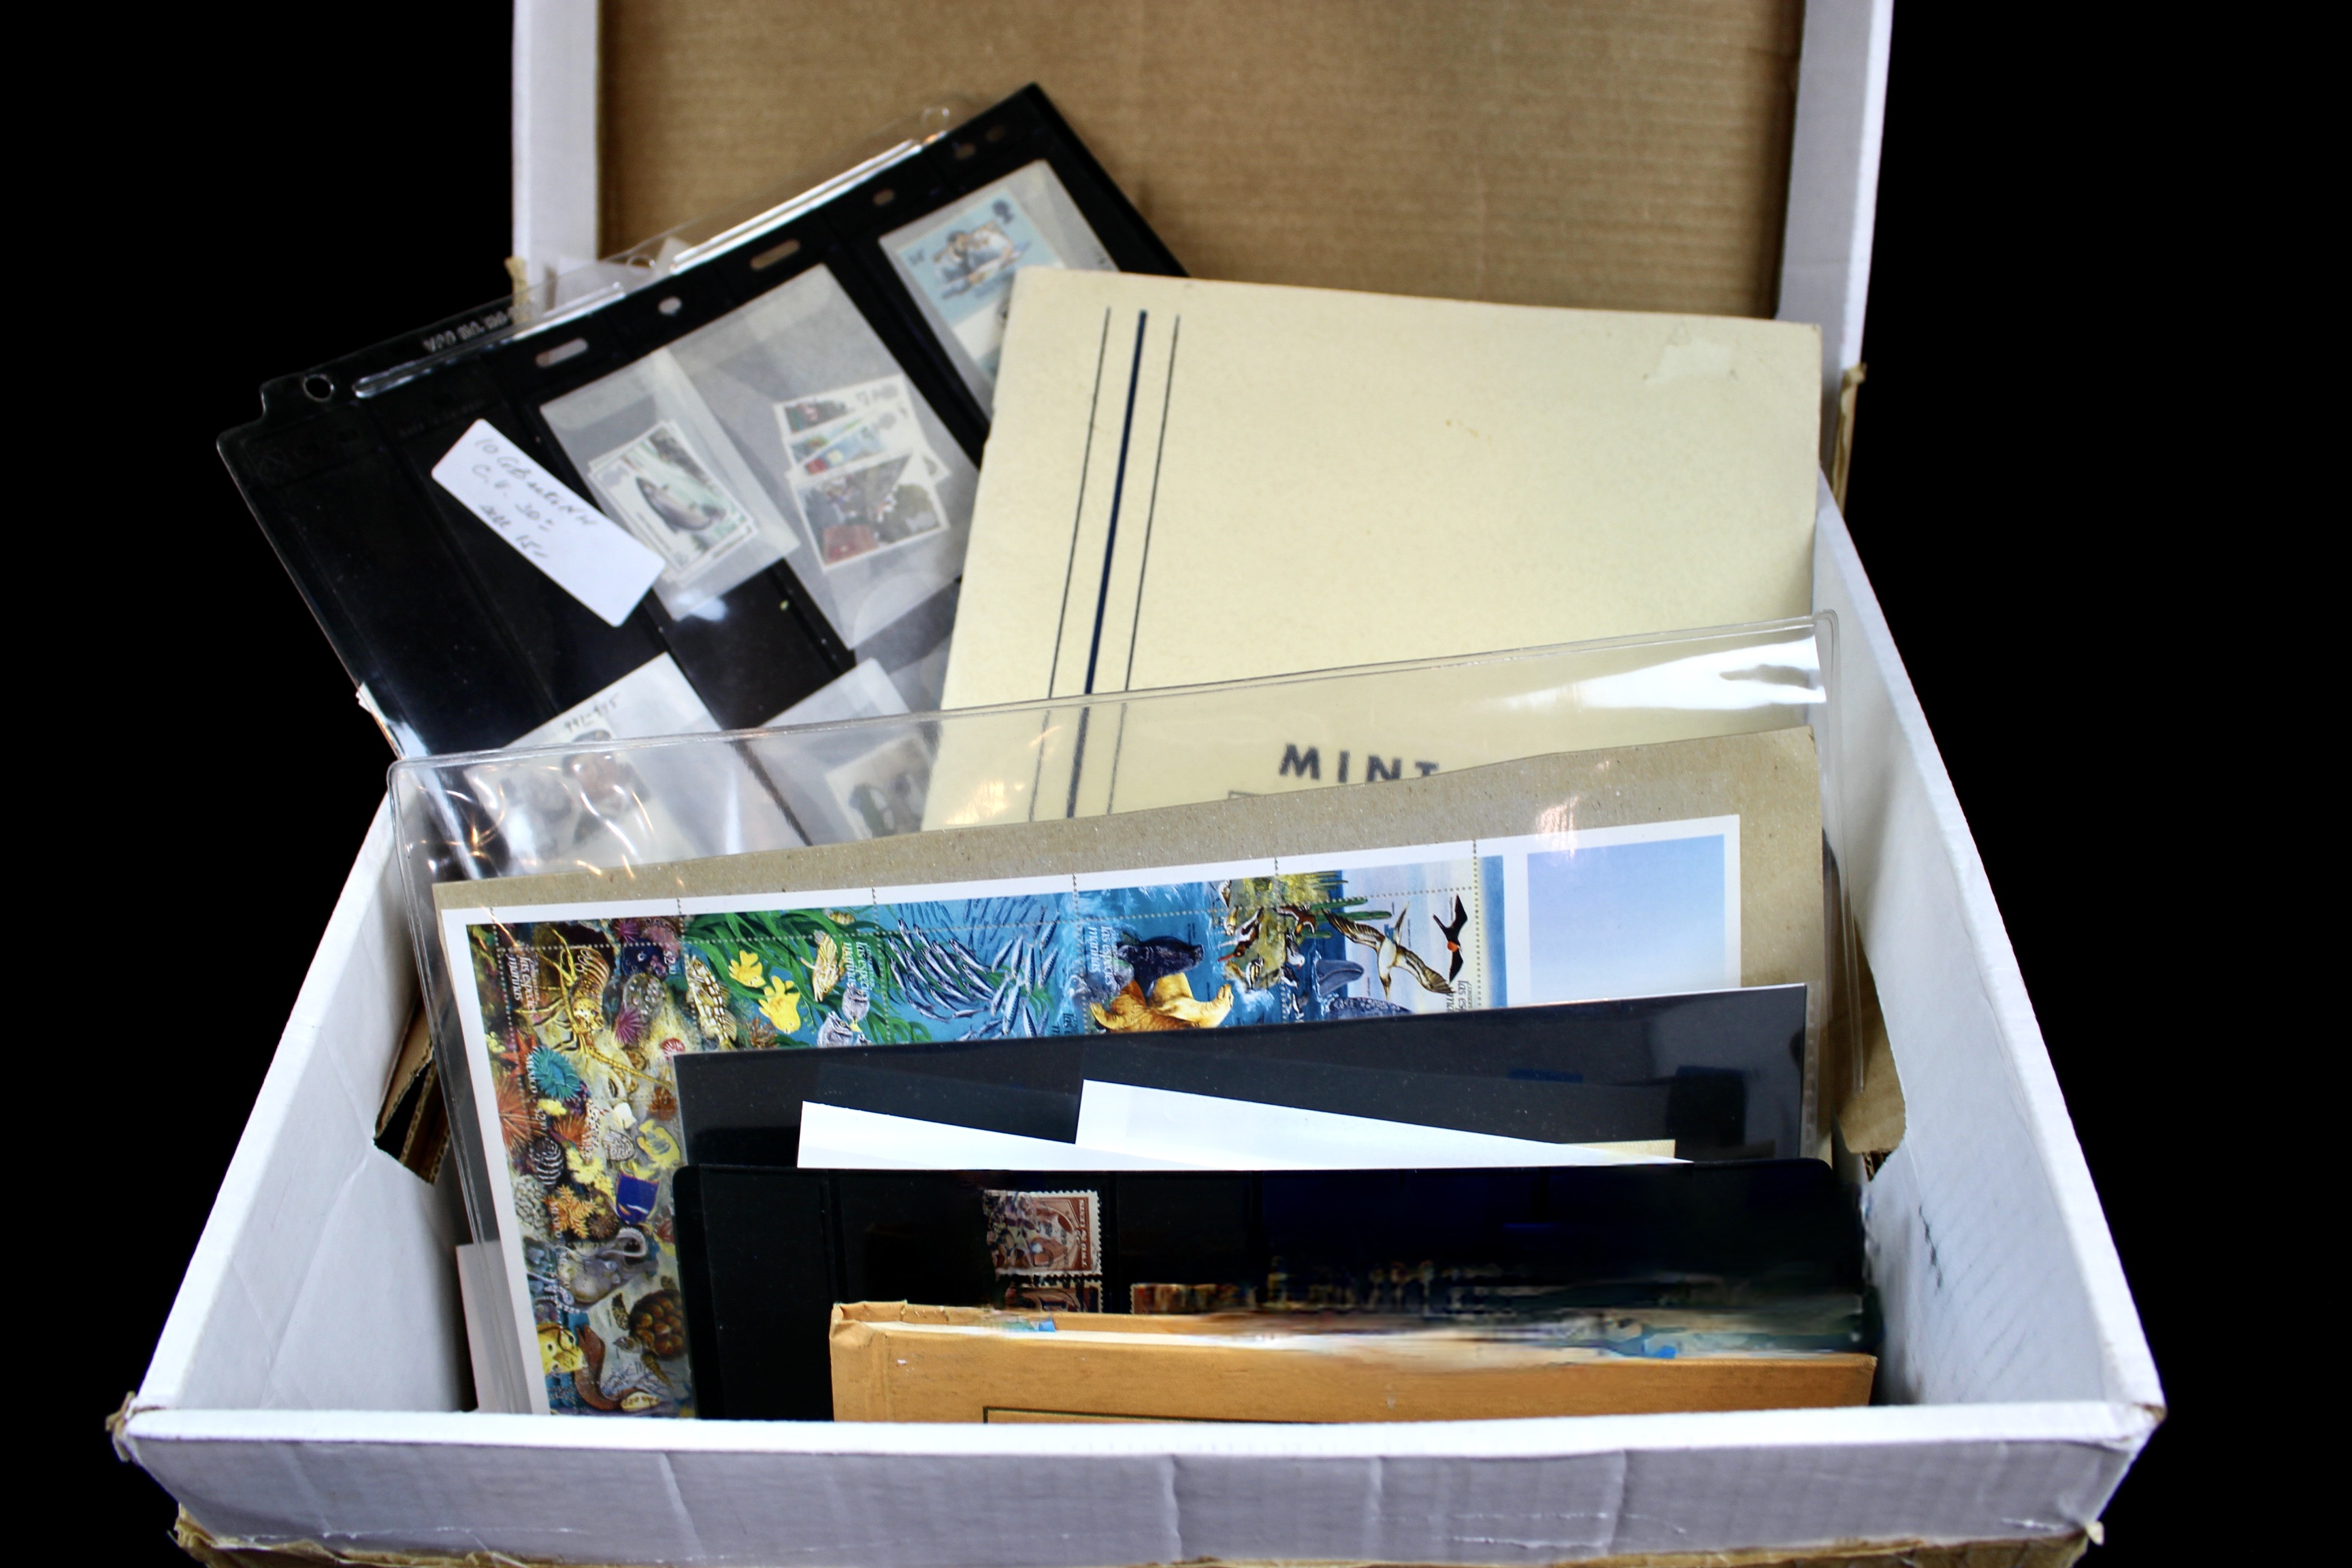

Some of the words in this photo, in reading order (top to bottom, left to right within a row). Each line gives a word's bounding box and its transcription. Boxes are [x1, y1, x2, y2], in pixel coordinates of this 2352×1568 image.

[1279, 742, 1440, 784] MINT
[1101, 926, 1114, 943] las
[855, 941, 869, 958] las
[1088, 926, 1104, 973] marinas
[519, 956, 532, 973] las
[1100, 944, 1117, 985] especies
[506, 954, 523, 1001] marinas
[1458, 980, 1470, 995] las
[1063, 1013, 1076, 1028] las
